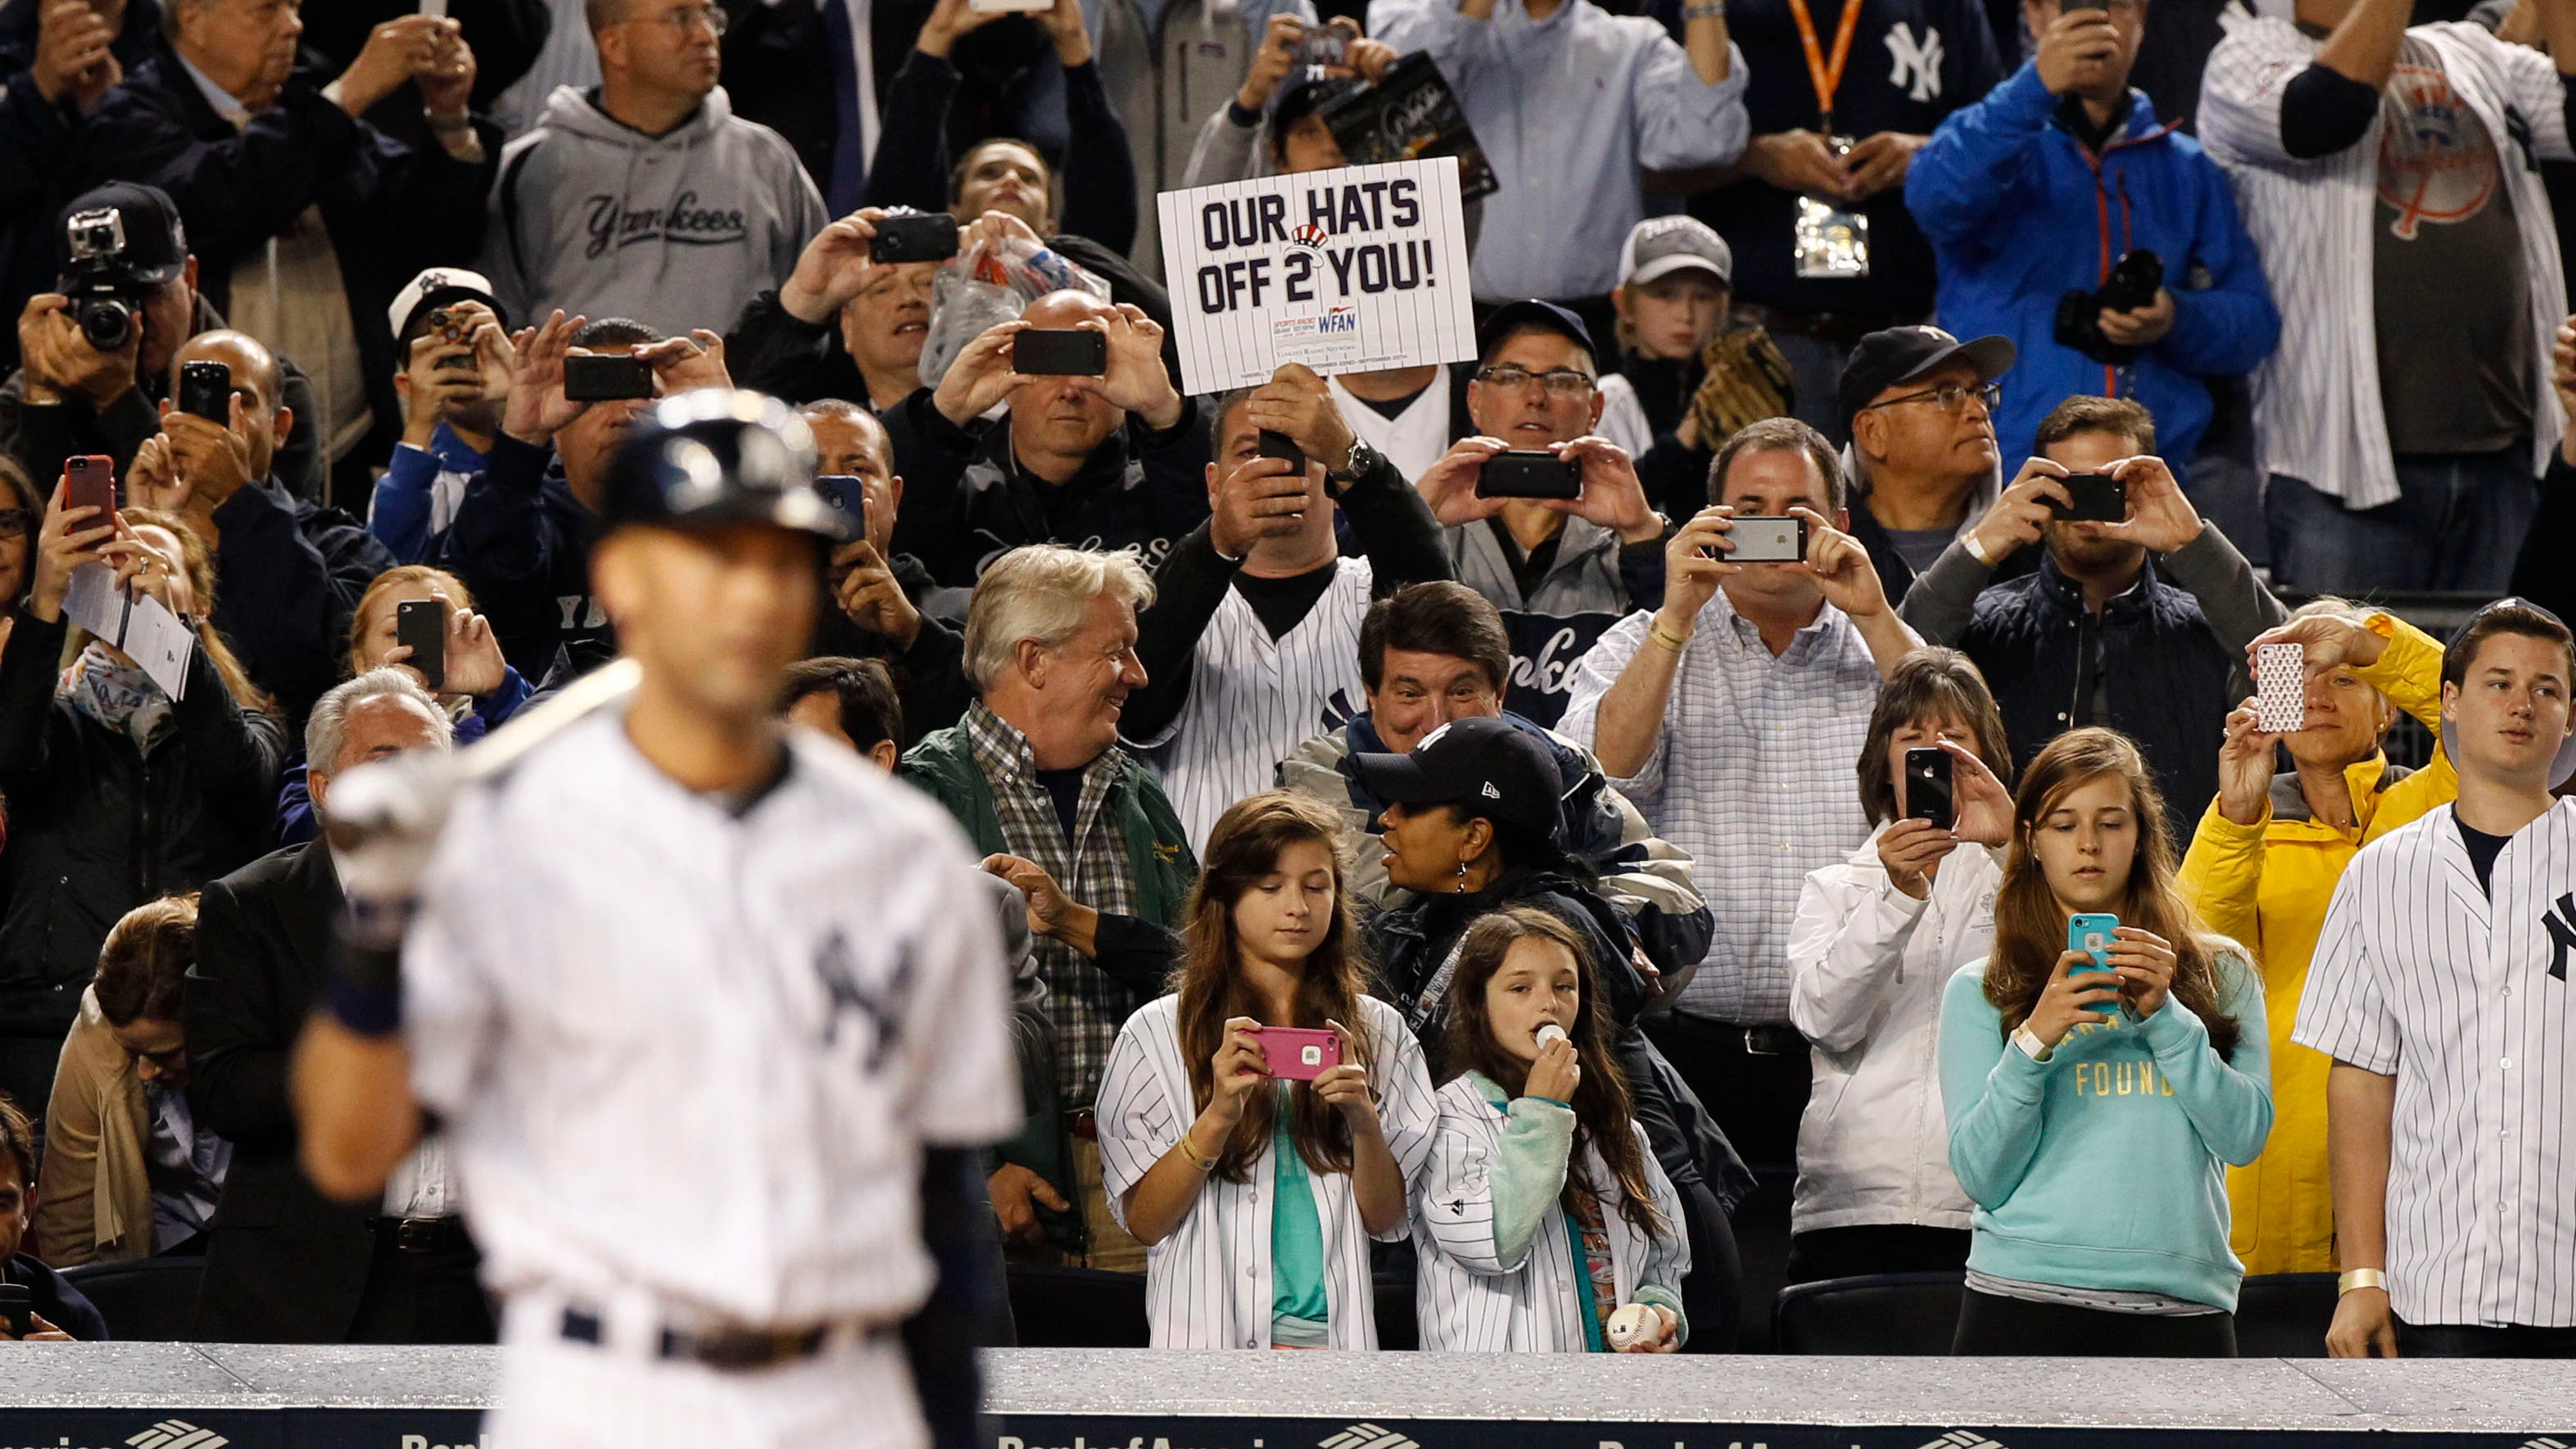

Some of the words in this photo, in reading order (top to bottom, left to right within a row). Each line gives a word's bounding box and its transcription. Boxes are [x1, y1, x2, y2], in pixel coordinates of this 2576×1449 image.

[582, 191, 747, 260] Yankees
[1202, 193, 1288, 251] OUR
[1307, 178, 1419, 236] HATS
[1197, 257, 1270, 315] OFF
[1283, 252, 1314, 302] 2
[1327, 239, 1436, 297] YOU!
[1318, 308, 1356, 333] WFAN
